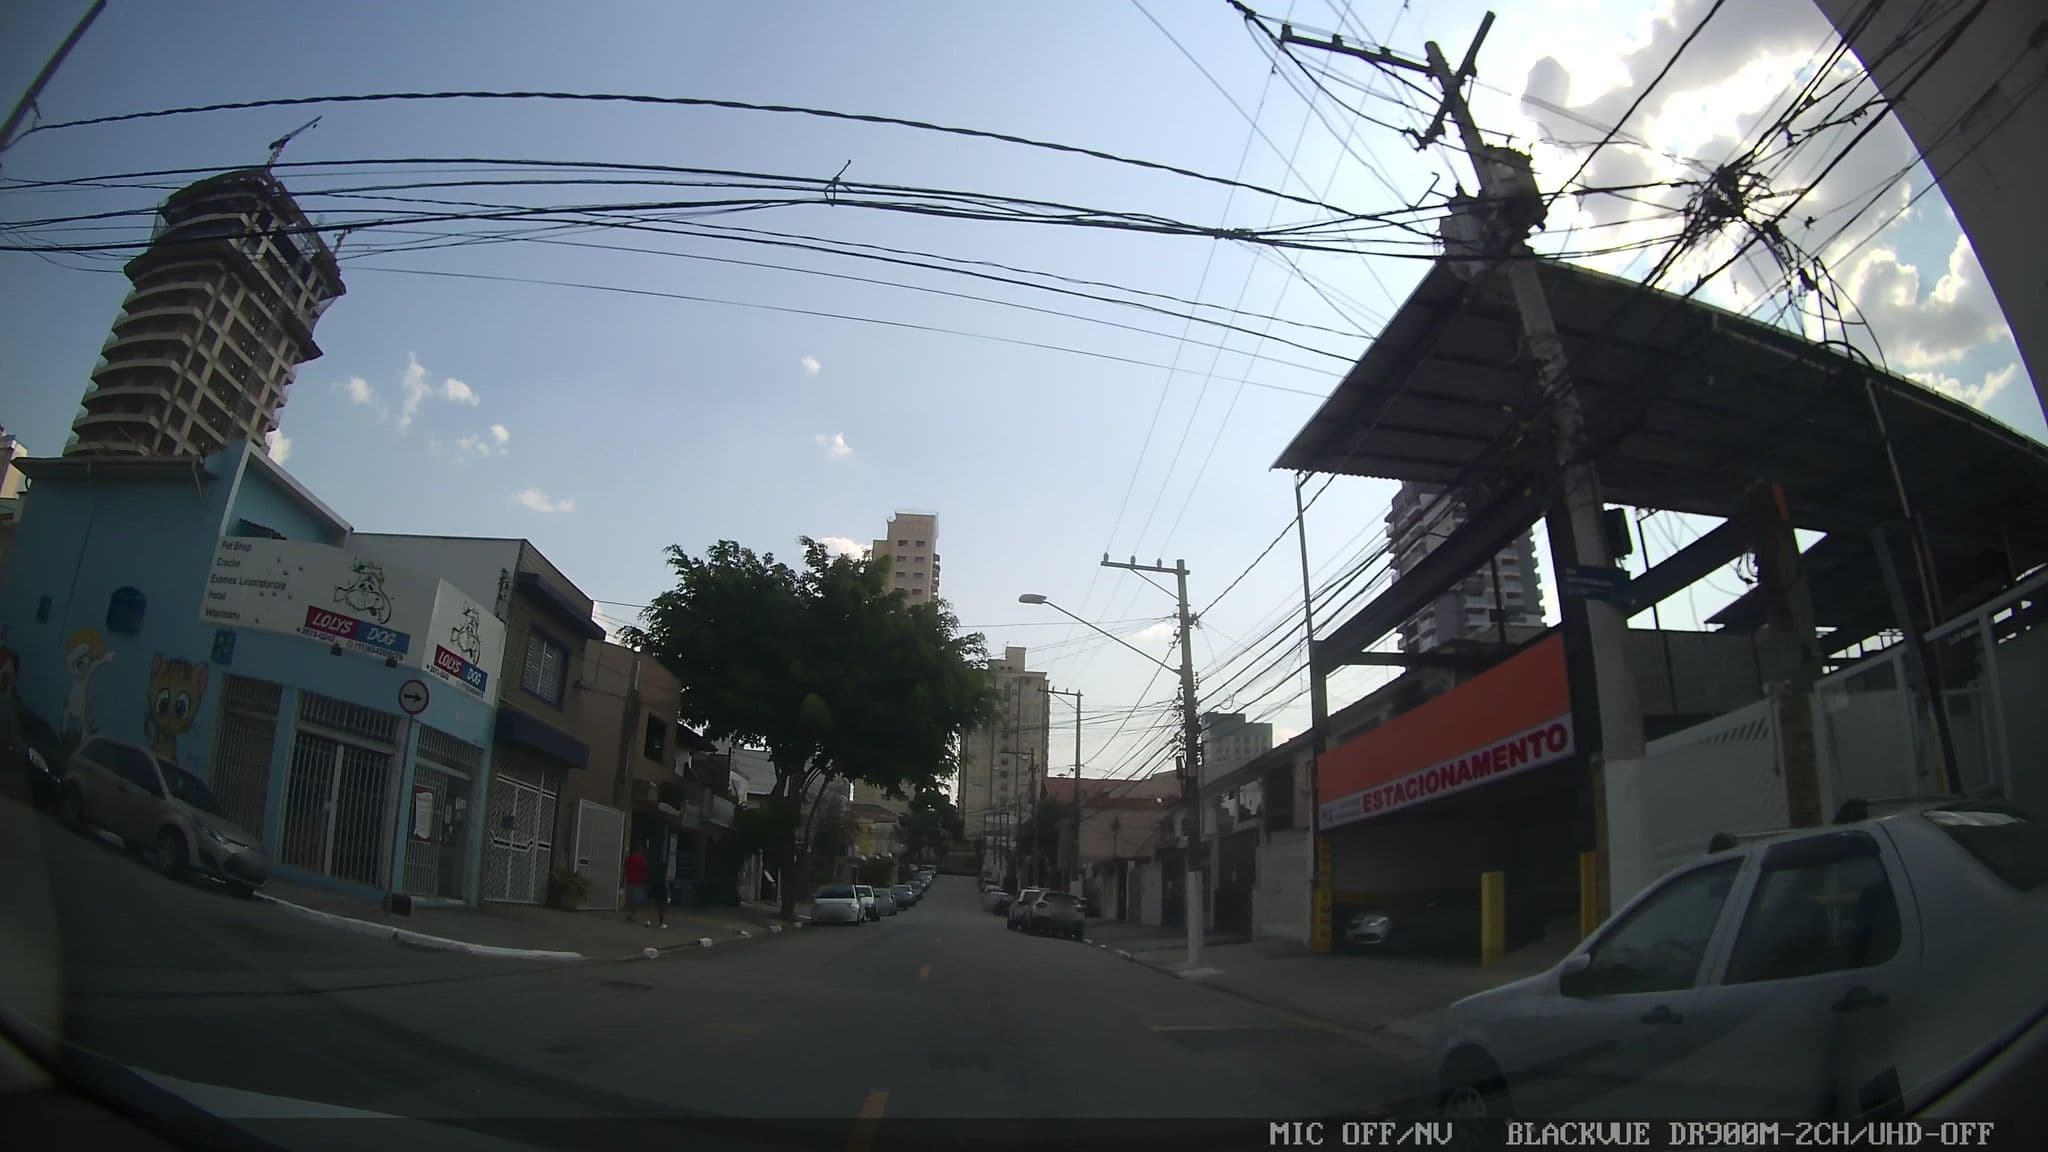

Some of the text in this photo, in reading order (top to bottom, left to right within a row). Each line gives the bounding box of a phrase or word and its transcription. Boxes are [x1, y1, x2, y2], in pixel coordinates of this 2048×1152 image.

[312, 612, 398, 645] LOLYS DOG
[438, 651, 462, 673] LOLYS
[466, 667, 482, 686] DOG
[1362, 723, 1569, 813] ESTACIONAMENTO
